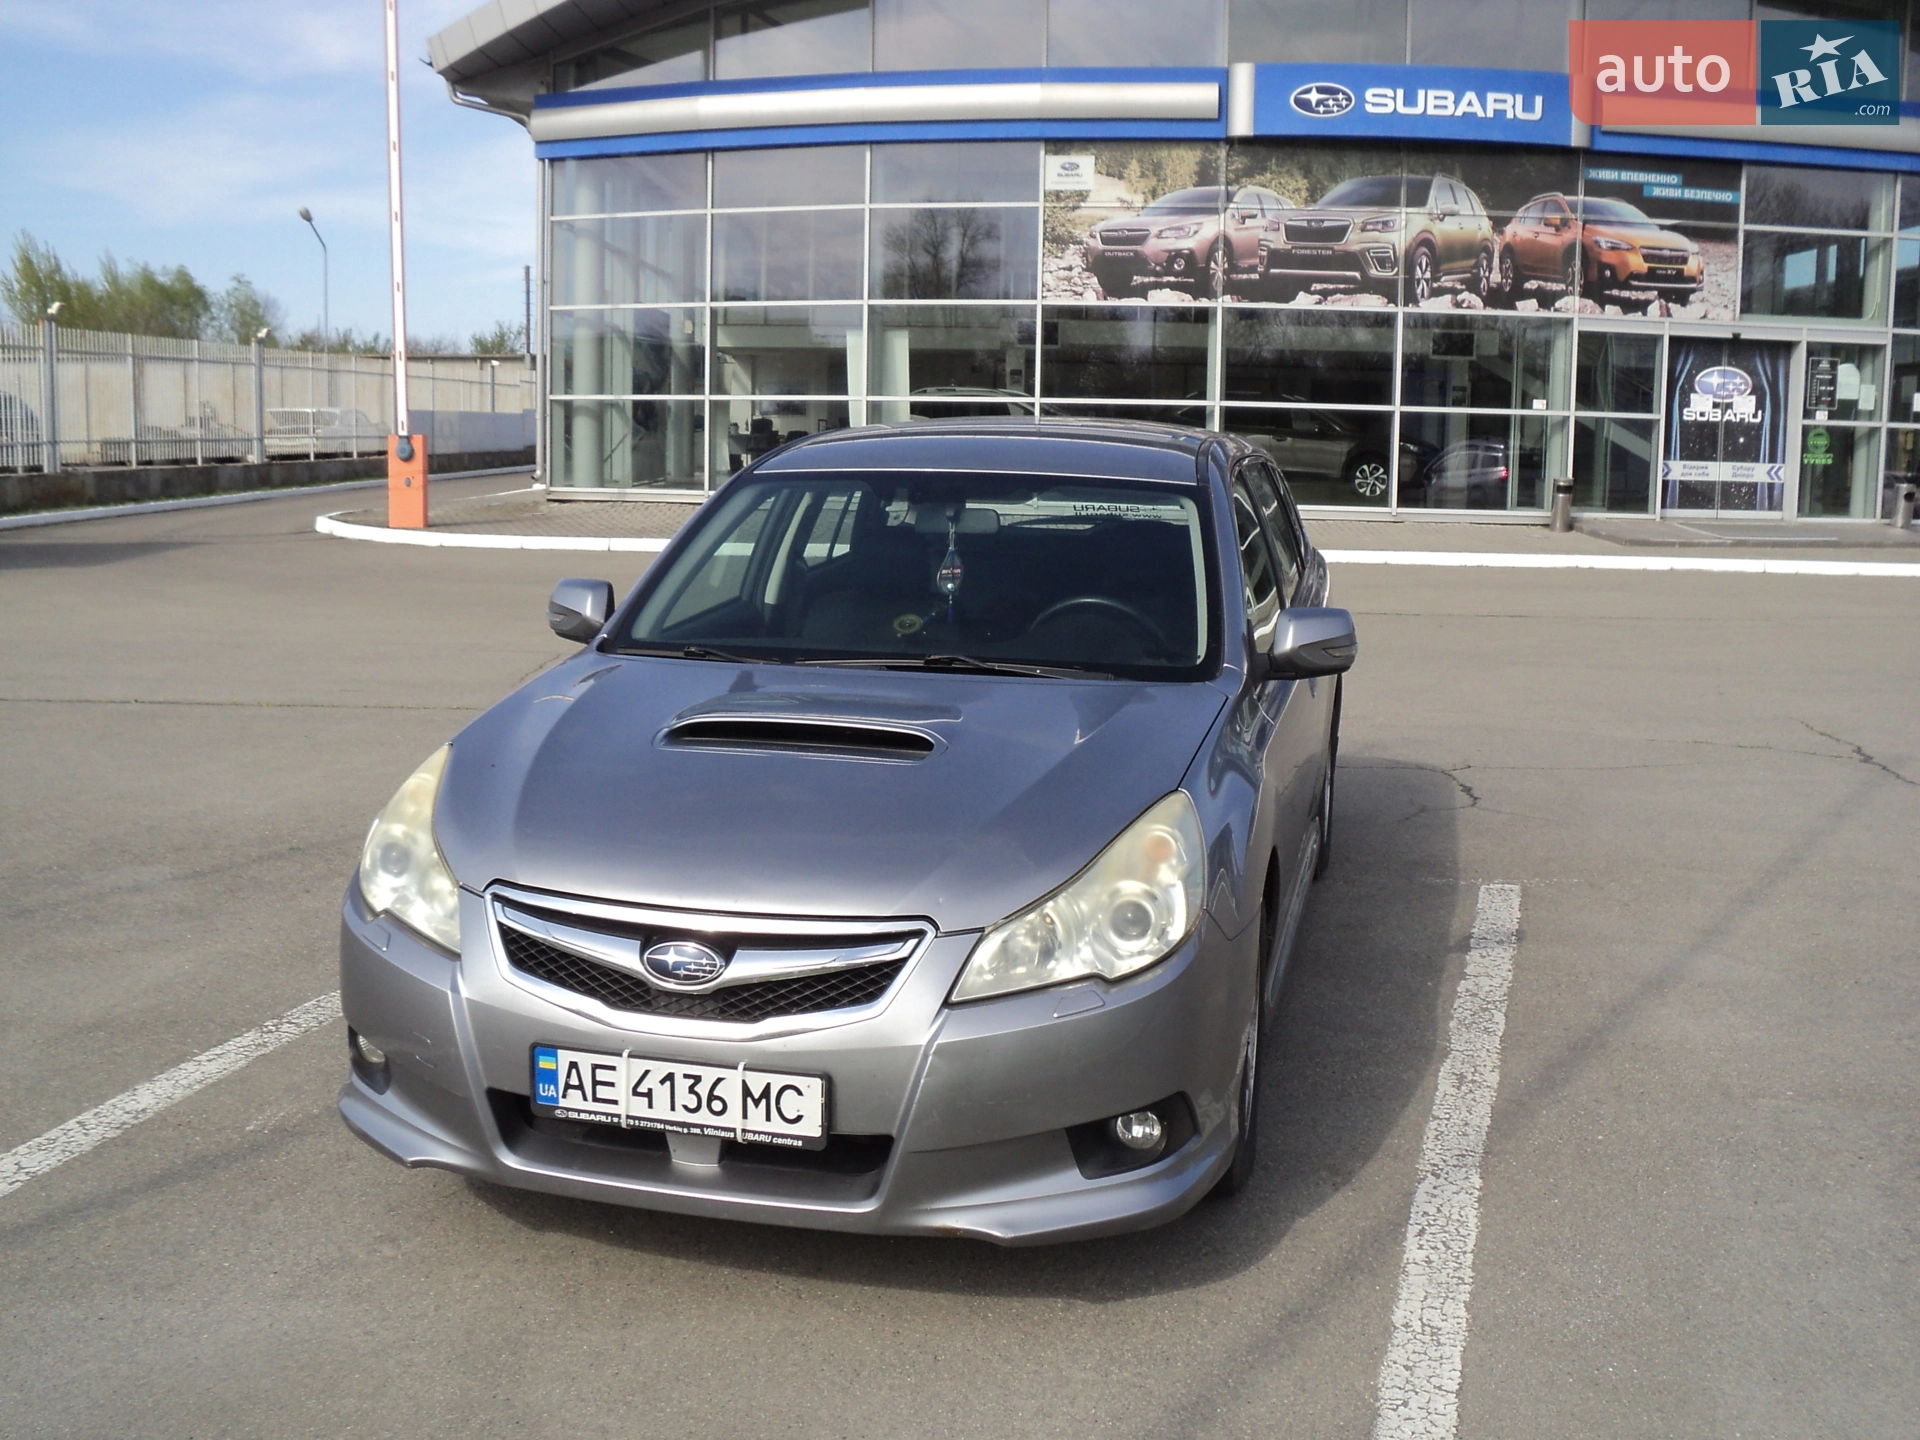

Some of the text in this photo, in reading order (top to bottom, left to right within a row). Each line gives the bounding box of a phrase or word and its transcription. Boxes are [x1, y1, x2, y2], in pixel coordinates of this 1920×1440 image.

[1364, 87, 1543, 121] SUBARU
[1588, 169, 1678, 184] ЖИВИ ВПЕВНЕННО
[1652, 186, 1733, 201] ЖИВИ БЕЗПЕЧНО
[1682, 408, 1763, 423] SUBARU
[539, 1083, 557, 1098] UA
[561, 1060, 805, 1125] AE 4136 MC
[568, 1112, 612, 1123] SUBARU
[703, 1127, 735, 1138] Vilniaus
[737, 1131, 772, 1143] UBARU
[772, 1136, 803, 1147] centras
